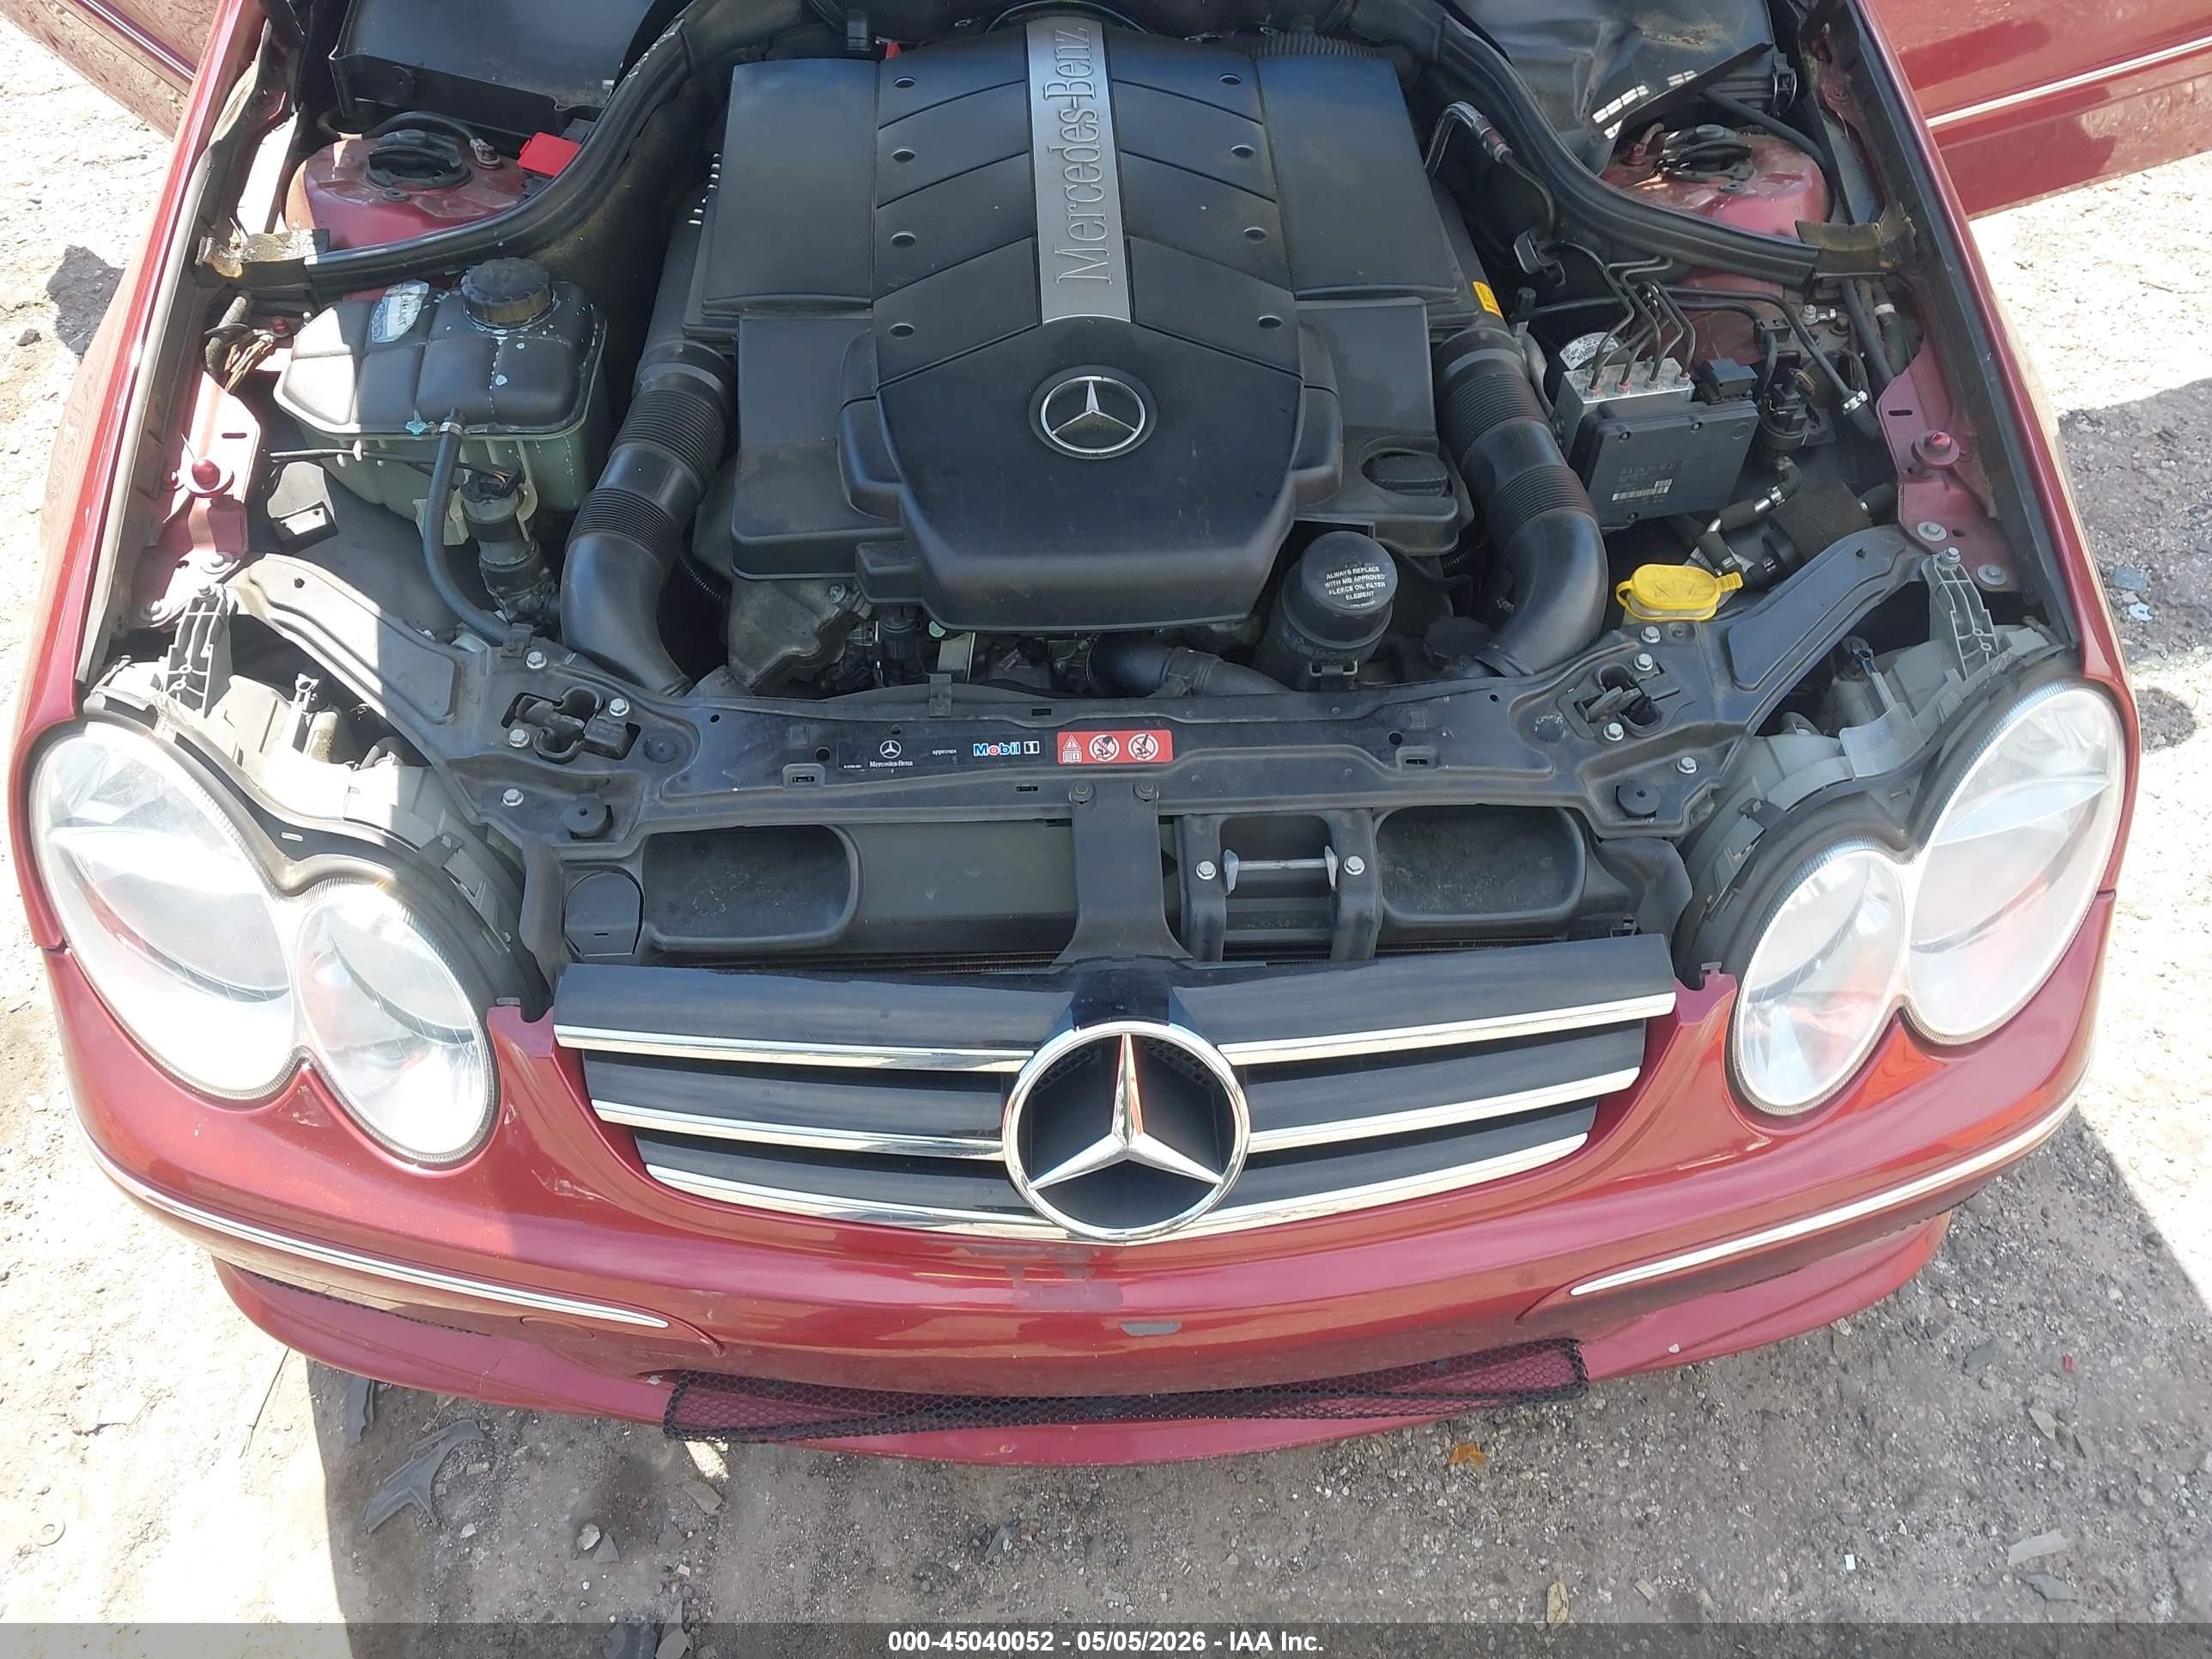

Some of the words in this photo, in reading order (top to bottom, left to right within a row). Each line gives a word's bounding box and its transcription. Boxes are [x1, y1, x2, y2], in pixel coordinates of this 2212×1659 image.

[1043, 27, 1112, 286] Mercedes-Benz
[1326, 568, 1352, 580] ALWAYS
[1352, 566, 1380, 574] REPLACE
[1324, 580, 1341, 589] WITH
[1353, 574, 1385, 583] APPROVED
[1328, 586, 1354, 595] FLEECE
[1345, 590, 1375, 600] ELEMENT
[973, 741, 1021, 757] Mobil
[1024, 740, 1040, 755] 1
[869, 759, 913, 768] Mercedes-Benz
